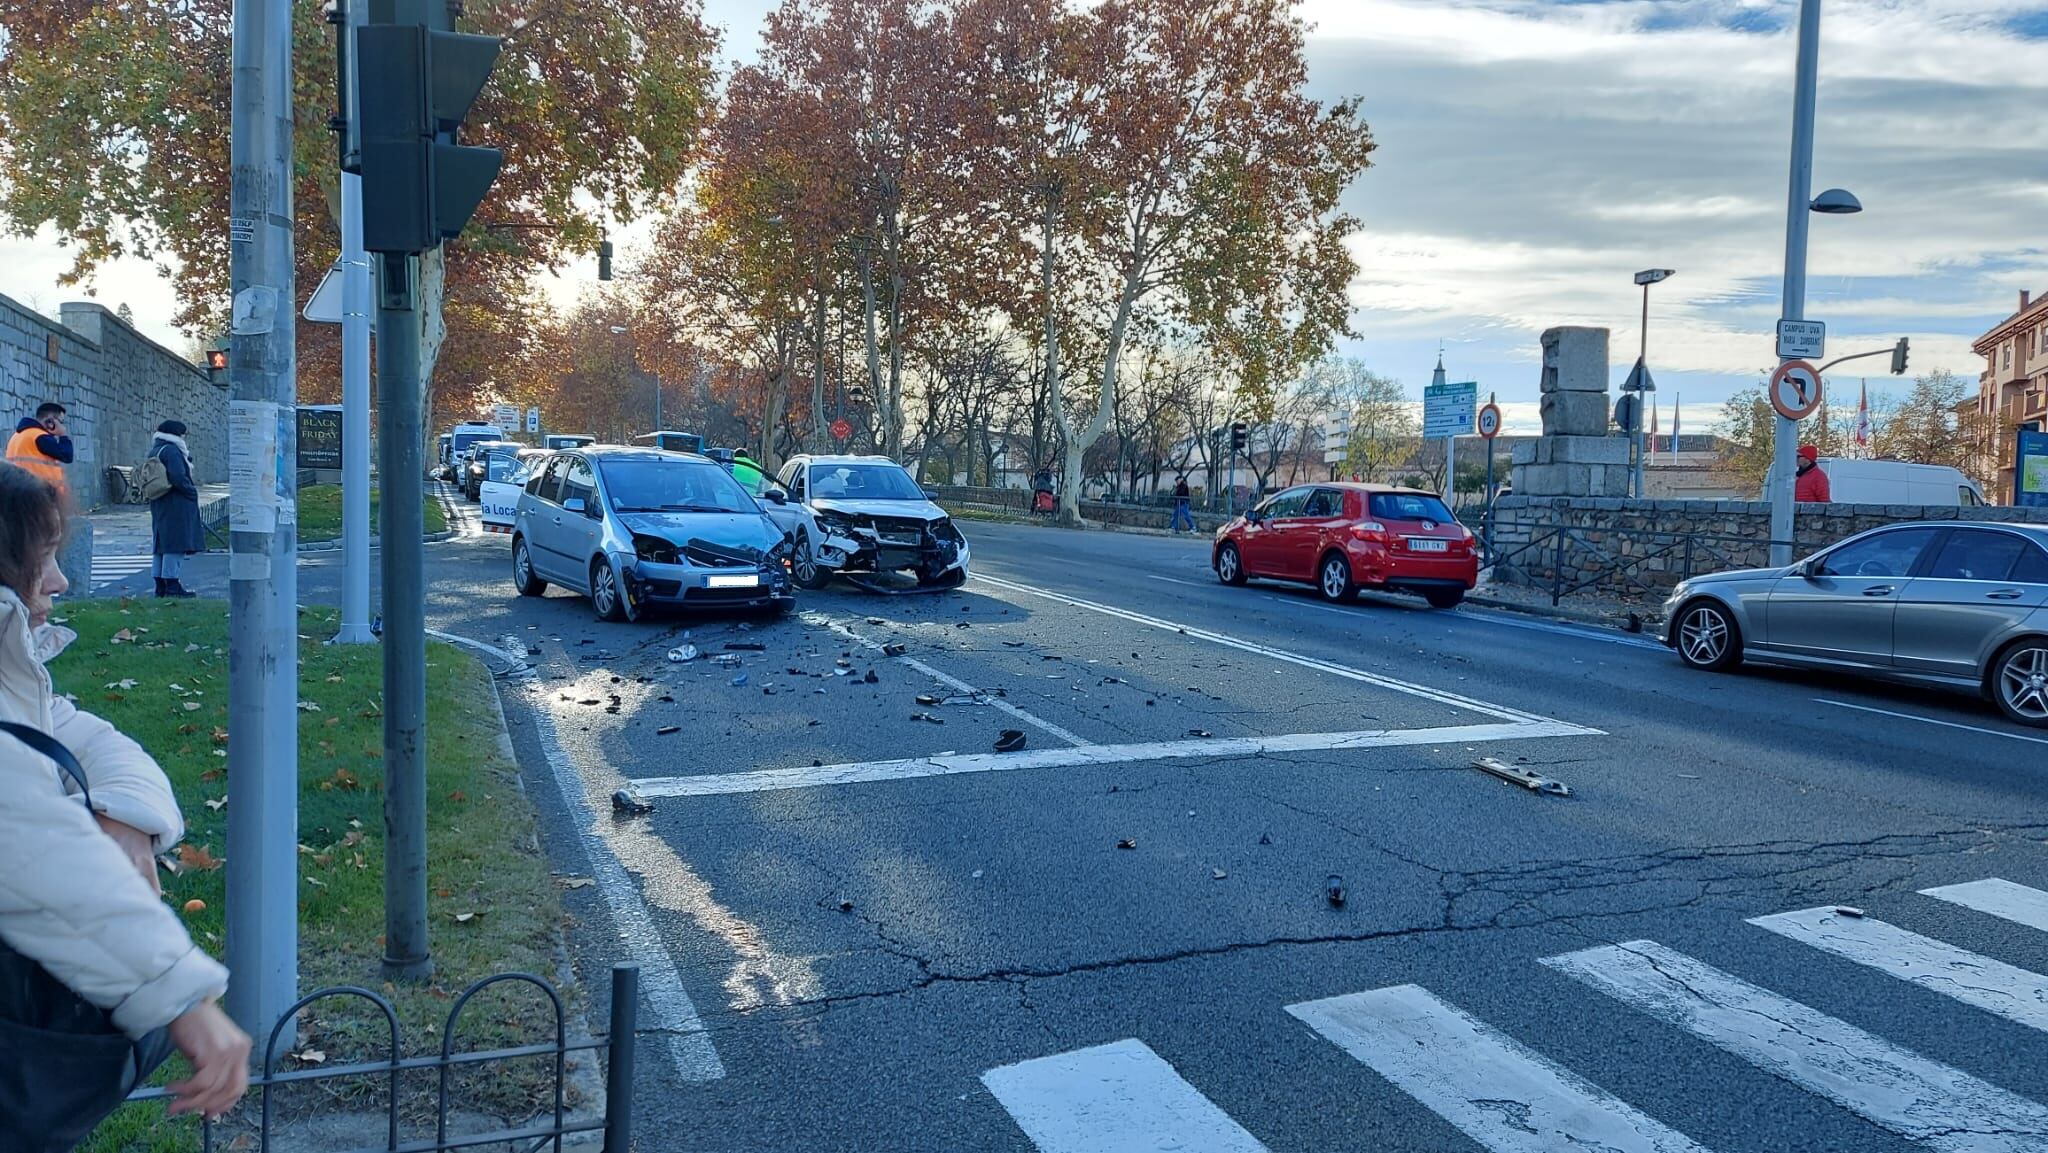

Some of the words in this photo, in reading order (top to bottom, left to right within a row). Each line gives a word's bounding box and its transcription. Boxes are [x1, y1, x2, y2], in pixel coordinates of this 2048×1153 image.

[1784, 324, 1805, 333] CAMPUS
[303, 418, 337, 427] BLACK
[302, 430, 338, 439] FRIDAY
[493, 503, 517, 517] Loca
